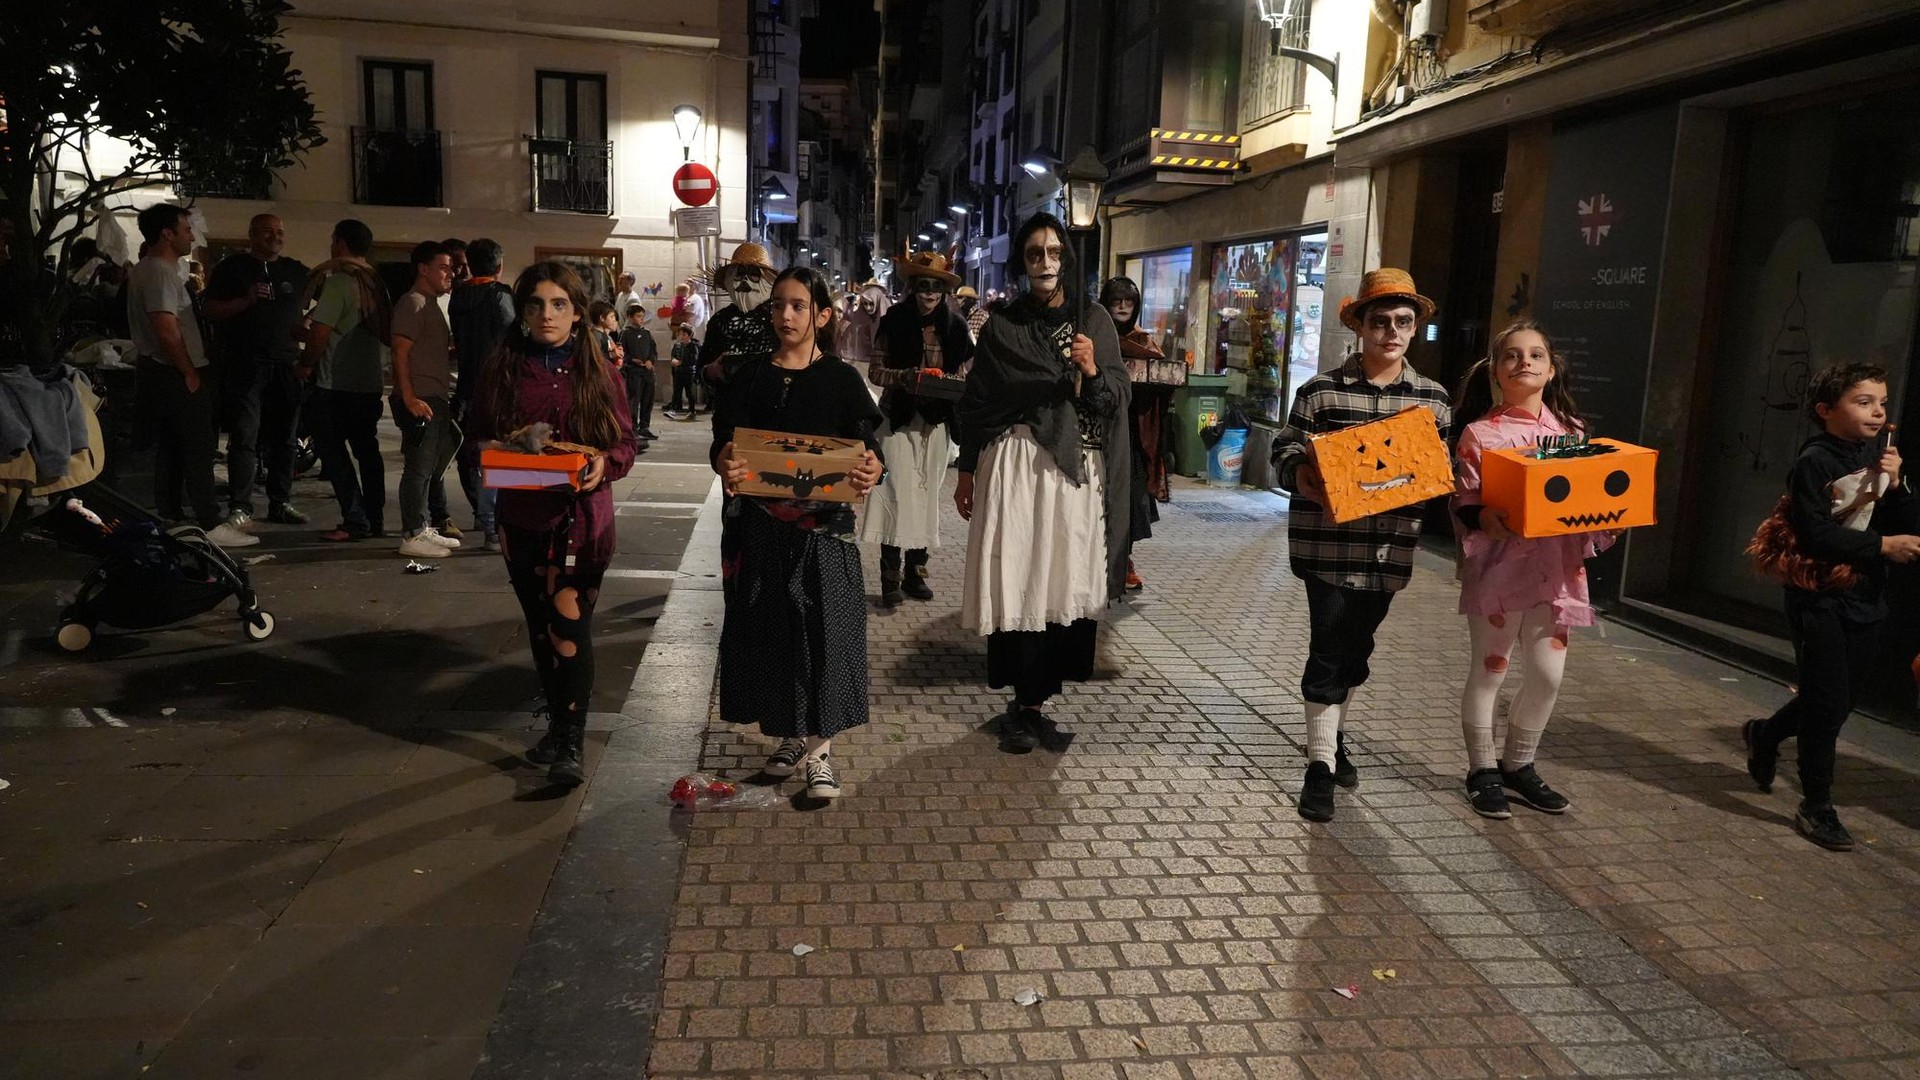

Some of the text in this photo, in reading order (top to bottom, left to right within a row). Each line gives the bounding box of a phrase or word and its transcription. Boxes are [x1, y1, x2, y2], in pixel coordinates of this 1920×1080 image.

[1552, 300, 1631, 310] SCHOOL OF ENGLISH
